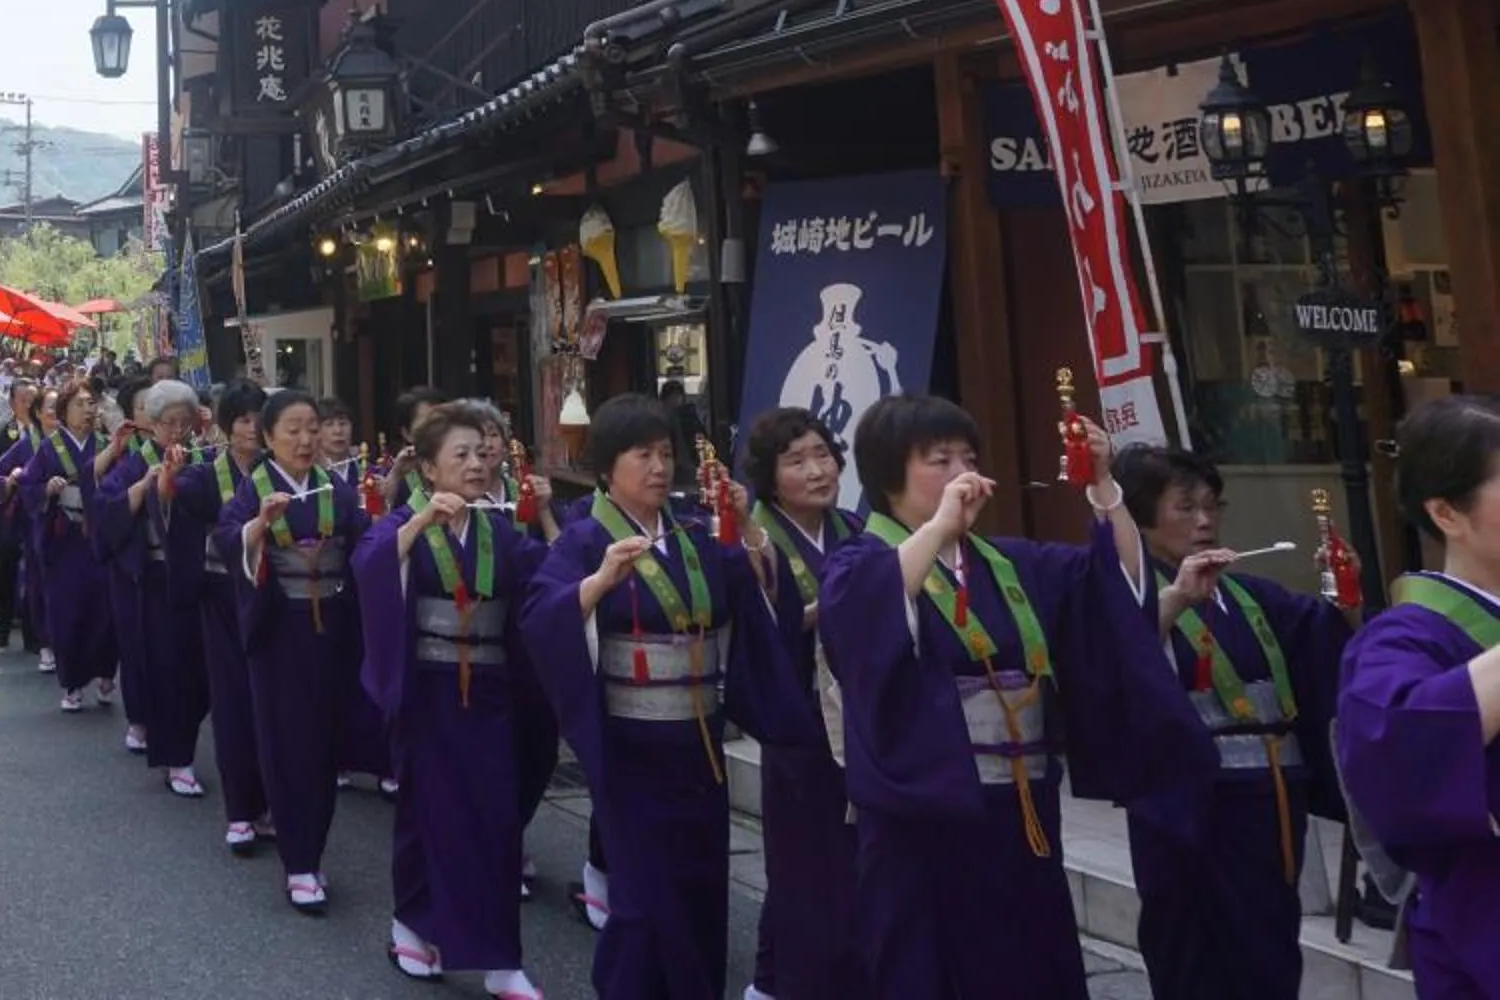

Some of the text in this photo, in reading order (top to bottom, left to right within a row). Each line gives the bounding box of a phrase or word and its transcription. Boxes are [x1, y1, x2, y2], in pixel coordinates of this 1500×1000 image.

[255, 16, 287, 102] 花兆庵
[990, 135, 1053, 171] SA
[771, 210, 933, 254] 城崎地ビール
[1296, 305, 1378, 333] WELCOME
